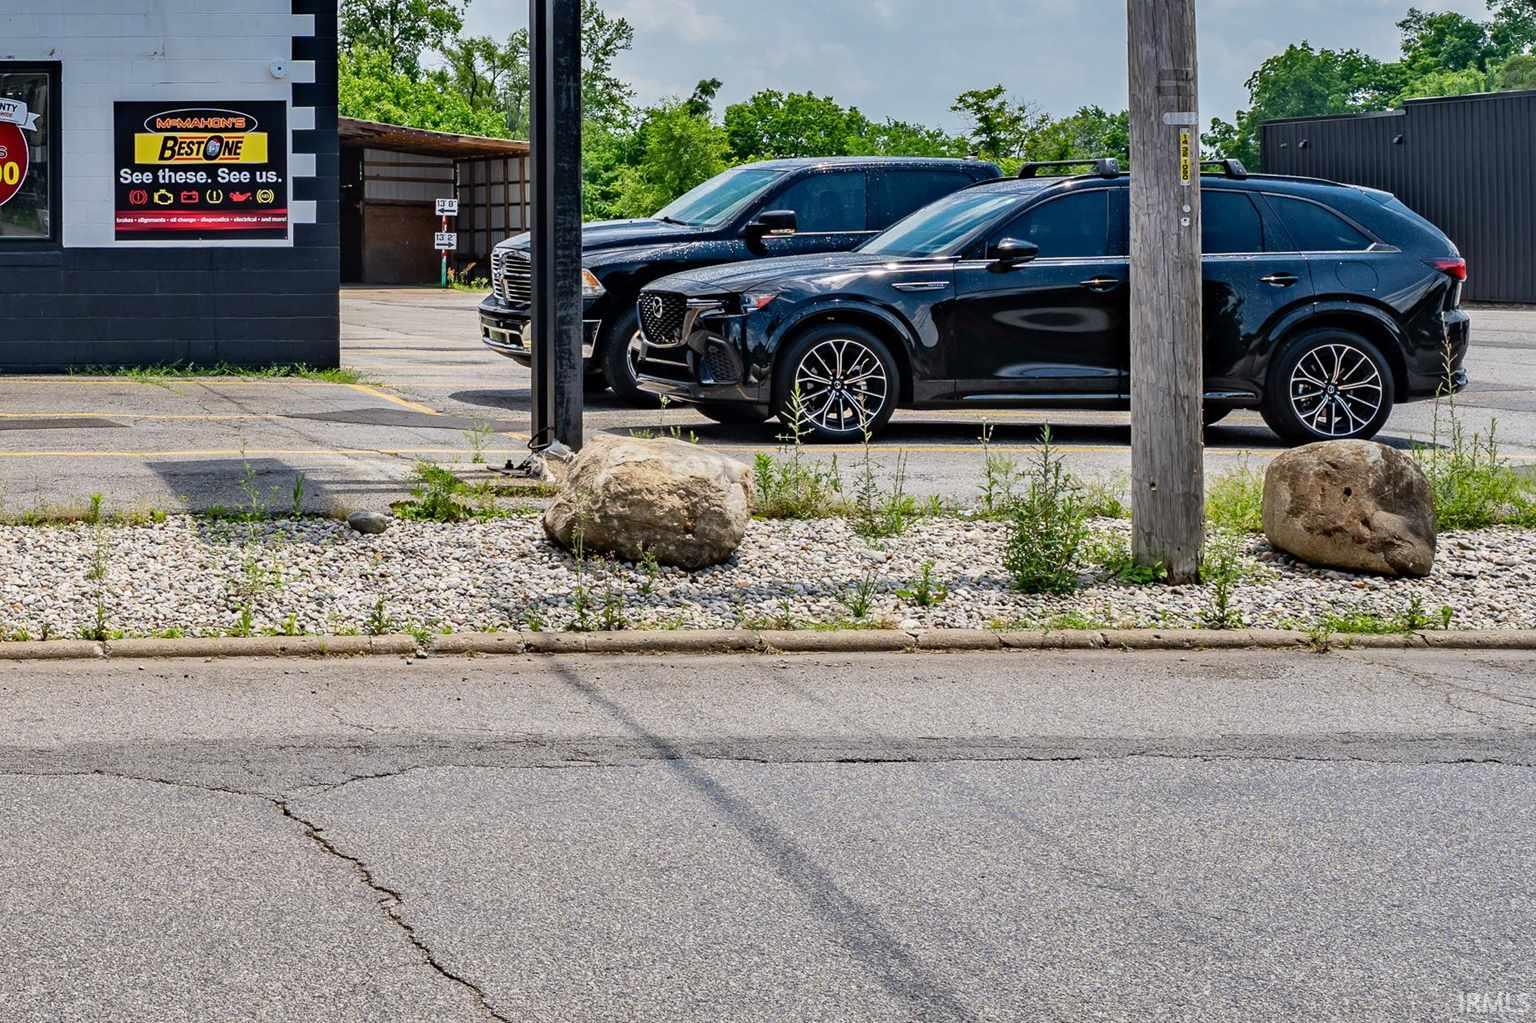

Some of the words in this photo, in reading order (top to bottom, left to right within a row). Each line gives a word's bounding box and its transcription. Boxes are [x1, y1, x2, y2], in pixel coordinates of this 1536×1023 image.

[120, 168, 153, 184] See
[157, 168, 212, 184] these.
[217, 168, 251, 184] See
[256, 170, 283, 183] us.
